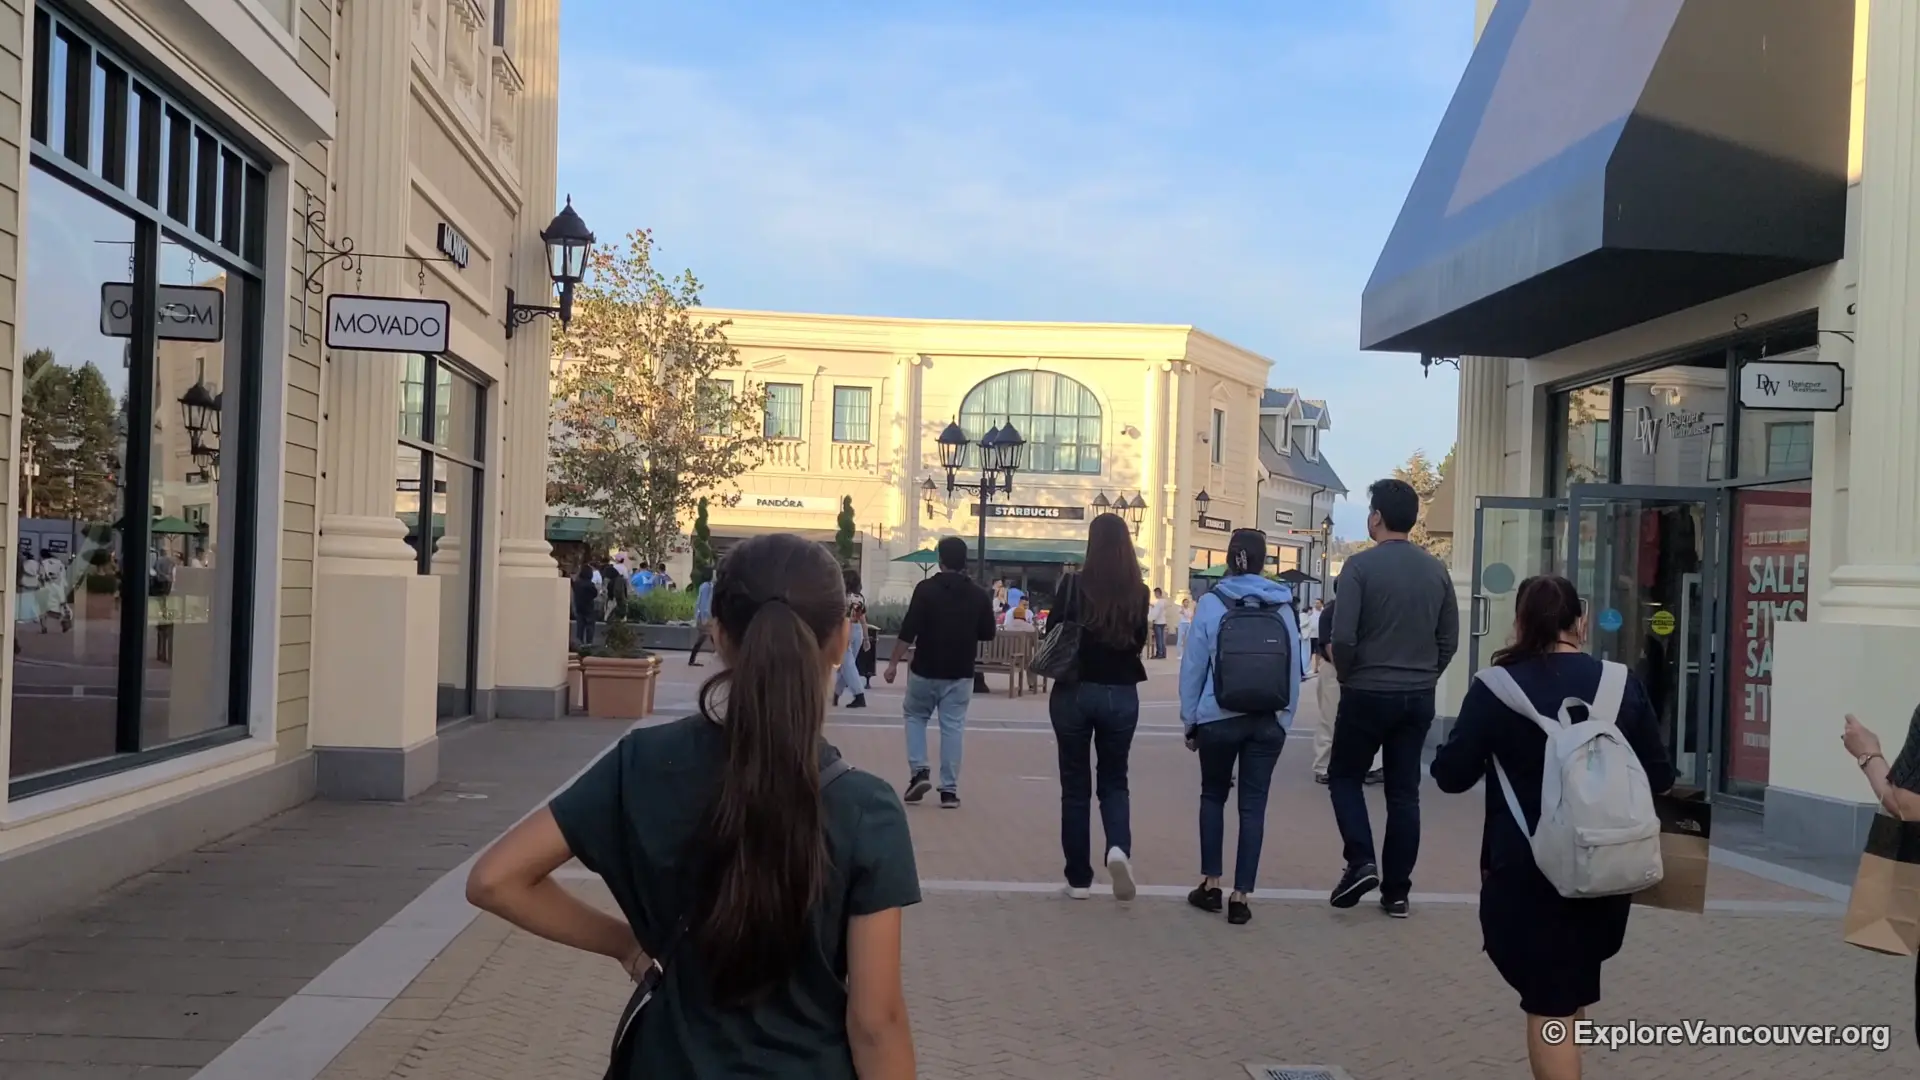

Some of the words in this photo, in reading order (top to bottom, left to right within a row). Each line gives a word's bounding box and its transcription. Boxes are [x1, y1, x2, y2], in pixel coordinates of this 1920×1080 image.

[334, 313, 440, 337] MOVADO
[1756, 374, 1780, 396] DW
[1635, 406, 1661, 455] DW
[995, 507, 1060, 517] STARBUCKS
[1747, 554, 1806, 594] SALE
